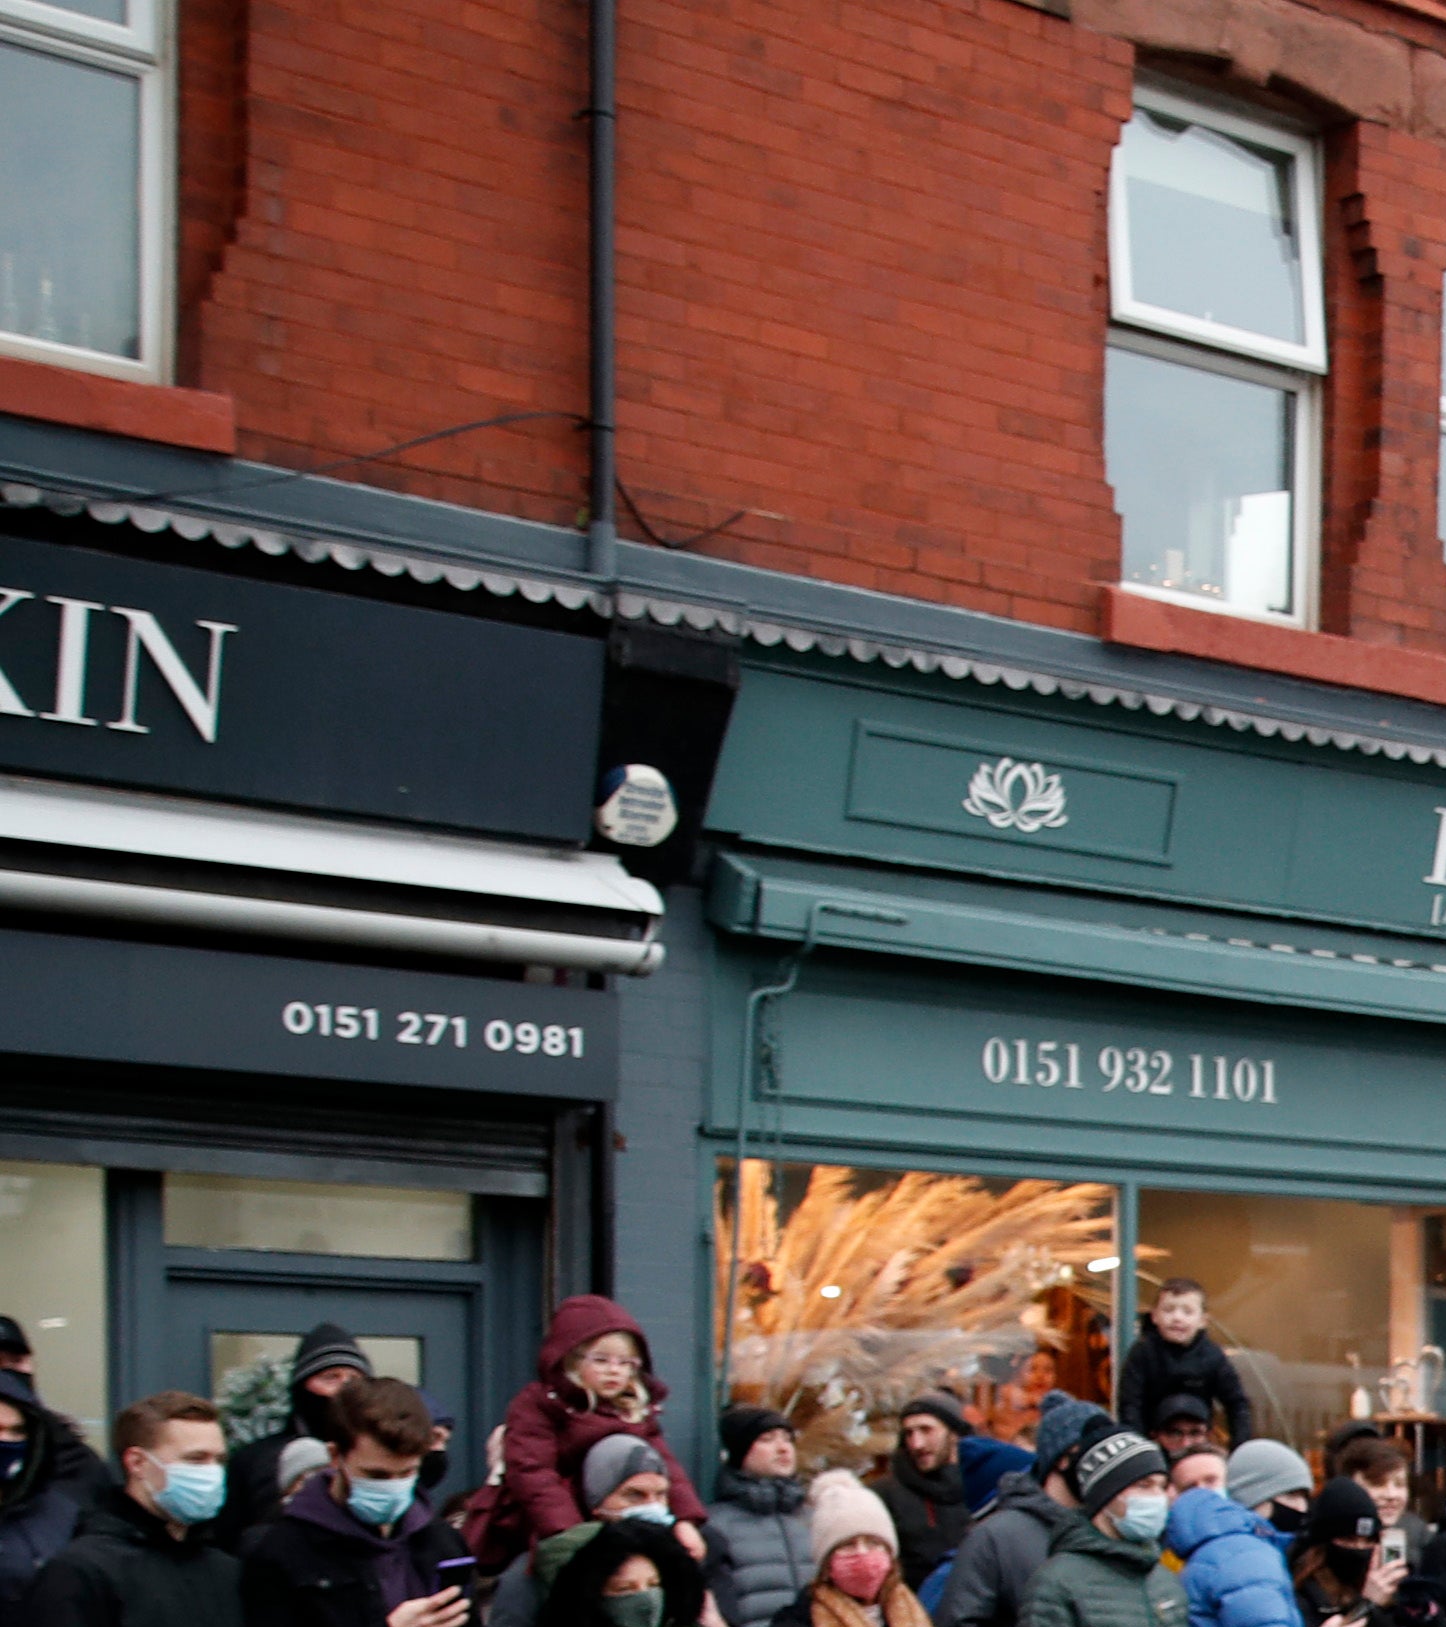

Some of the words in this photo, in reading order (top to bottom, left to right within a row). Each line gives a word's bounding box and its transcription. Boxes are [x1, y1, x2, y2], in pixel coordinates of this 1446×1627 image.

[282, 1001, 380, 1041] 0151
[396, 1011, 468, 1049] 271
[484, 1019, 584, 1059] 0981
[981, 1036, 1084, 1089] 0151
[1098, 1046, 1174, 1095] 932
[1188, 1053, 1278, 1104] 1101
